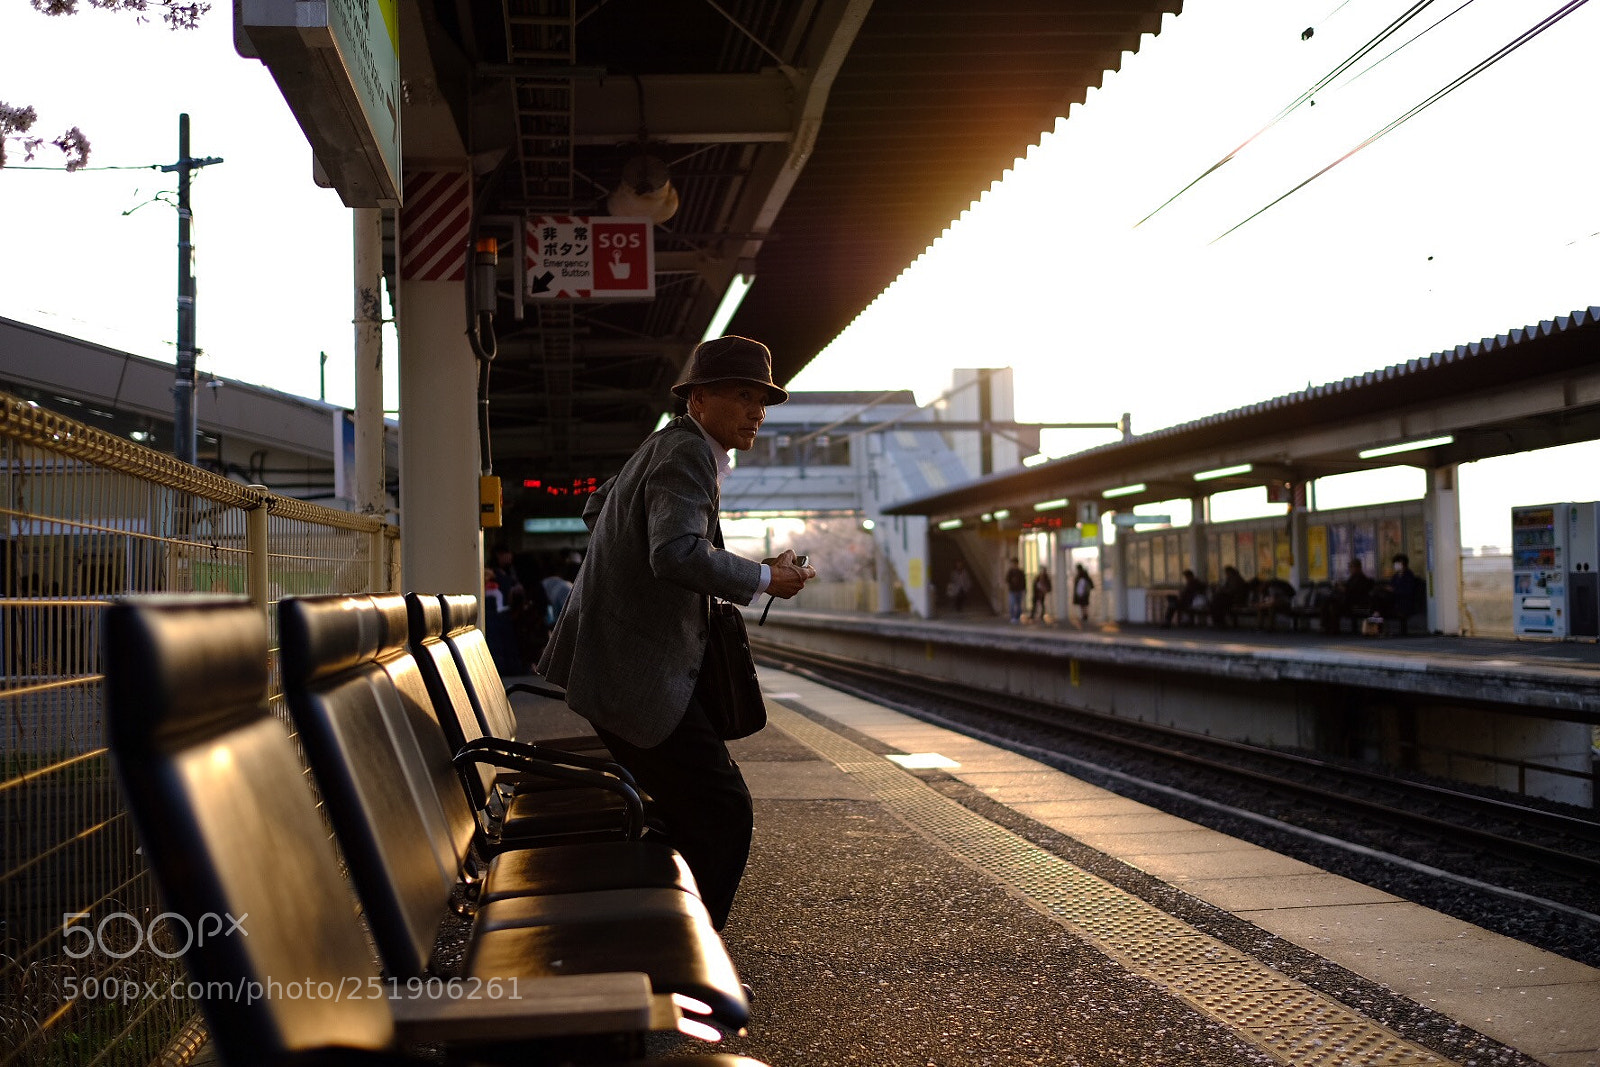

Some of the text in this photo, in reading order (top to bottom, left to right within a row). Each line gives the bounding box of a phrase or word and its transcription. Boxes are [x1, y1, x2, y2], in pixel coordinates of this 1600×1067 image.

[542, 226, 588, 241] 非常
[599, 232, 641, 249] SOS
[543, 242, 588, 257] ボタン
[543, 259, 589, 268] Emergency
[561, 268, 590, 277] Button
